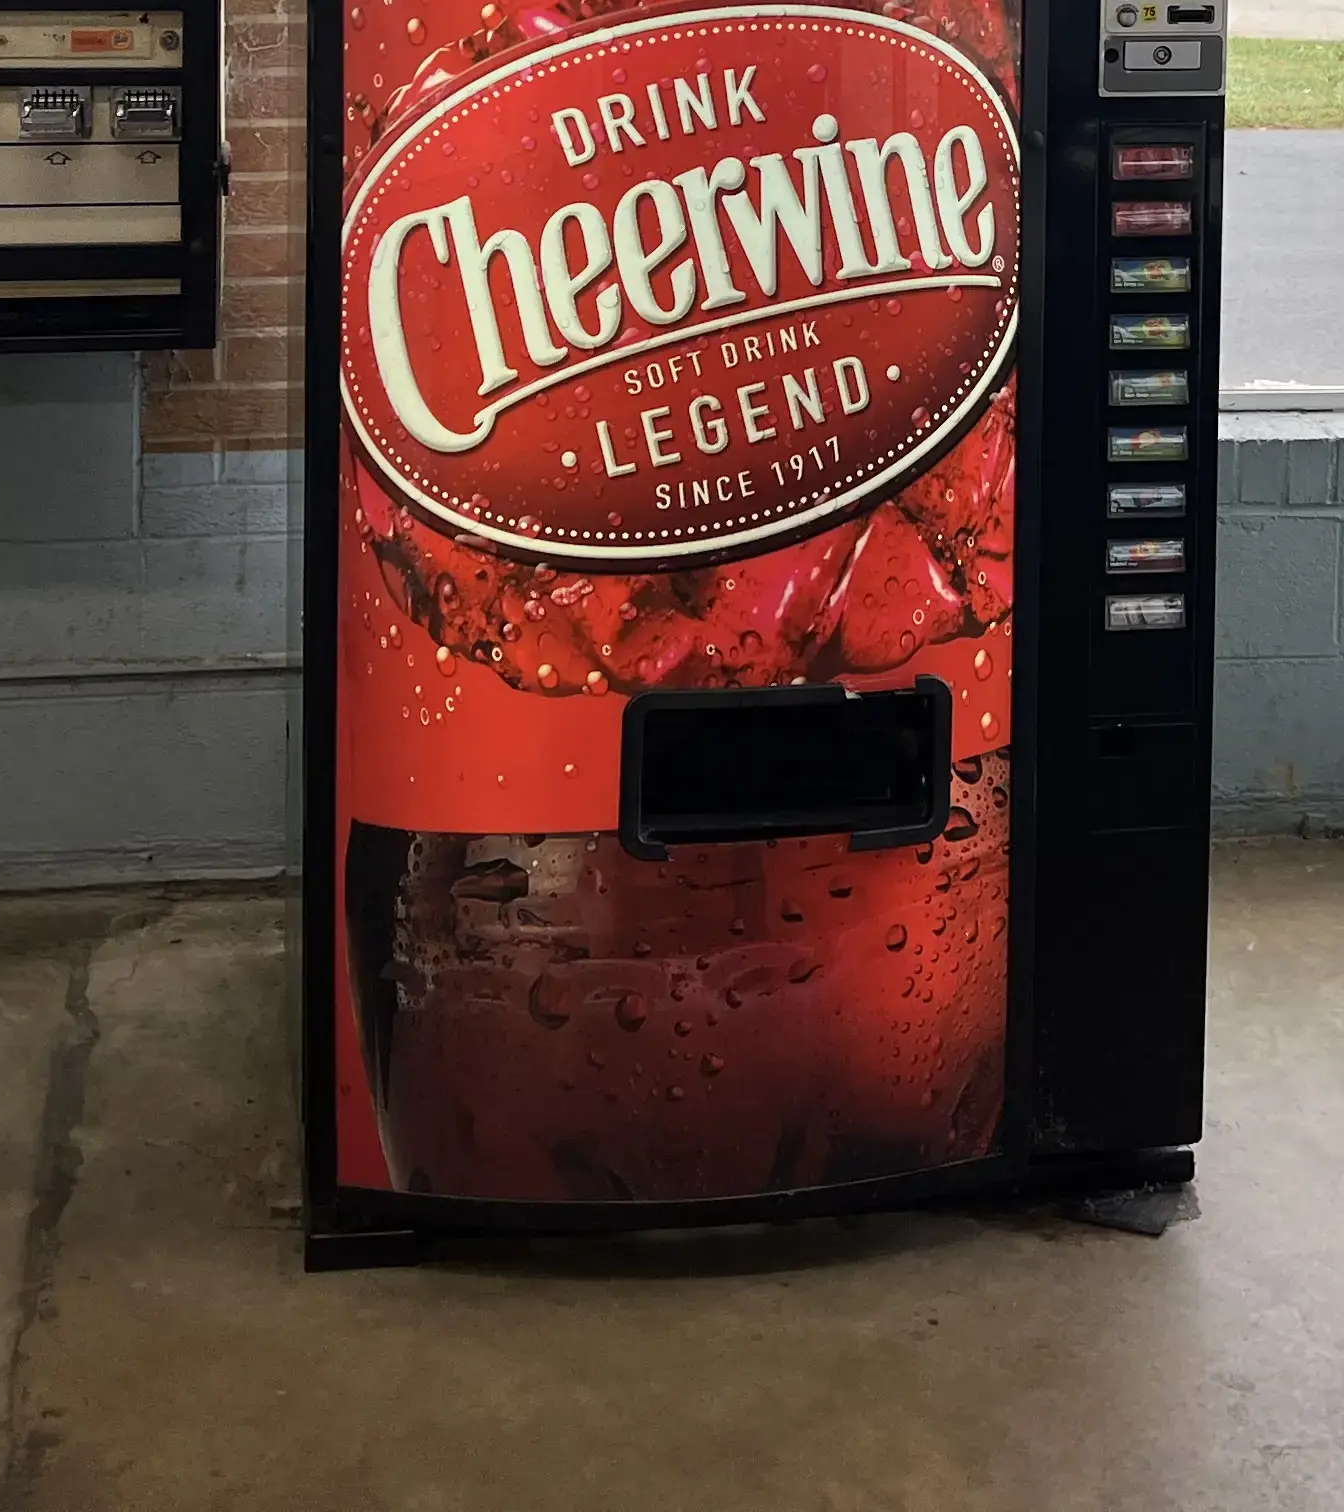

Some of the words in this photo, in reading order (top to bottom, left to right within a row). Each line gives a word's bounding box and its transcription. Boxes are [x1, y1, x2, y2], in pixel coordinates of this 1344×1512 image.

[551, 65, 766, 167] DRINK
[368, 113, 996, 453] Cheerwine
[623, 350, 703, 395] SOFT
[719, 321, 822, 369] DRINK
[595, 354, 871, 478] LEGEND
[655, 472, 756, 510] SINCE
[770, 435, 843, 485] 1917
